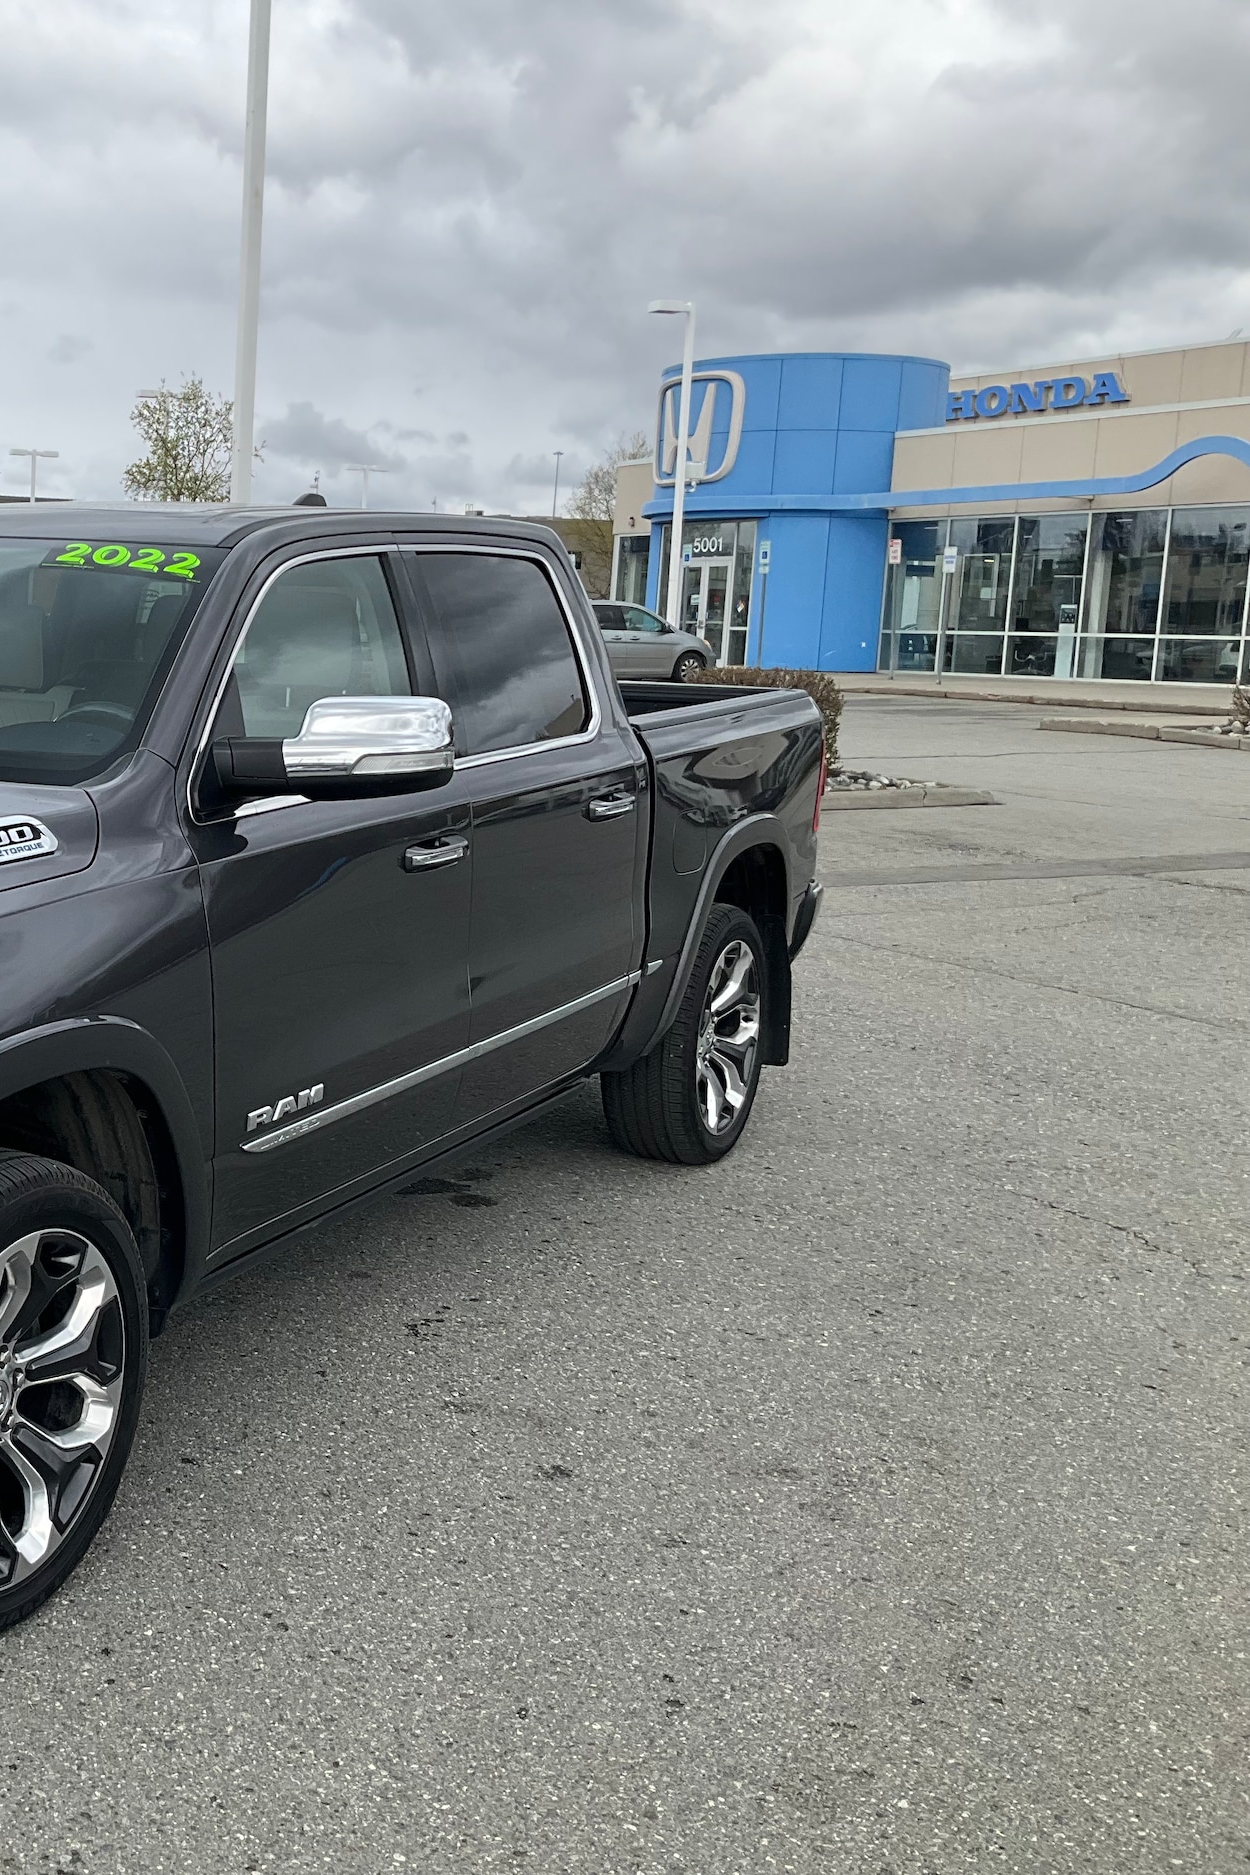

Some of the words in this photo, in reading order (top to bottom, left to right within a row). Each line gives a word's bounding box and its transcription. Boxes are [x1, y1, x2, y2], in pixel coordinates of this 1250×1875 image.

[946, 372, 1126, 420] HONDA
[56, 543, 200, 578] 2022
[693, 537, 723, 552] 5001
[246, 1082, 324, 1132] RAM
